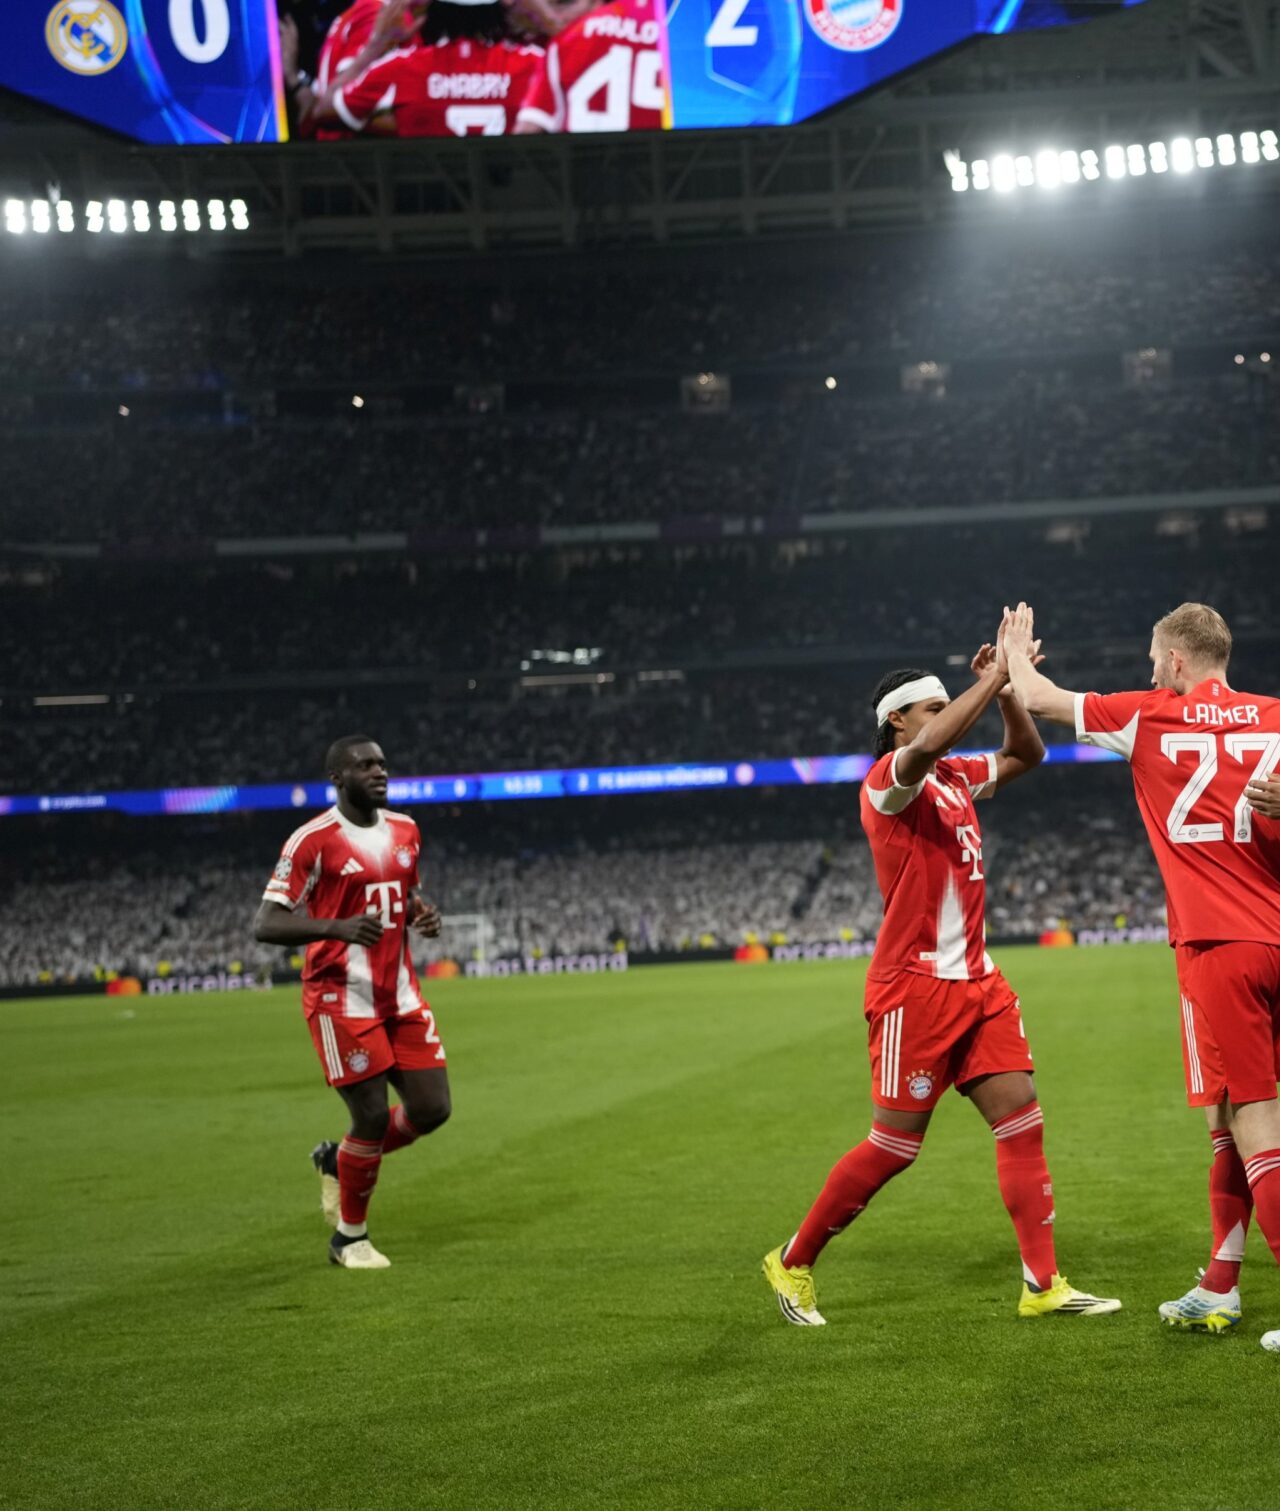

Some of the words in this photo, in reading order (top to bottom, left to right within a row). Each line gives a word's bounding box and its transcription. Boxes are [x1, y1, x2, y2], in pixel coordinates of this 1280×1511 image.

[168, 0, 230, 64] 0
[1183, 704, 1260, 725] LAIMER
[148, 971, 257, 997] priceles
[421, 1009, 440, 1043] 2
